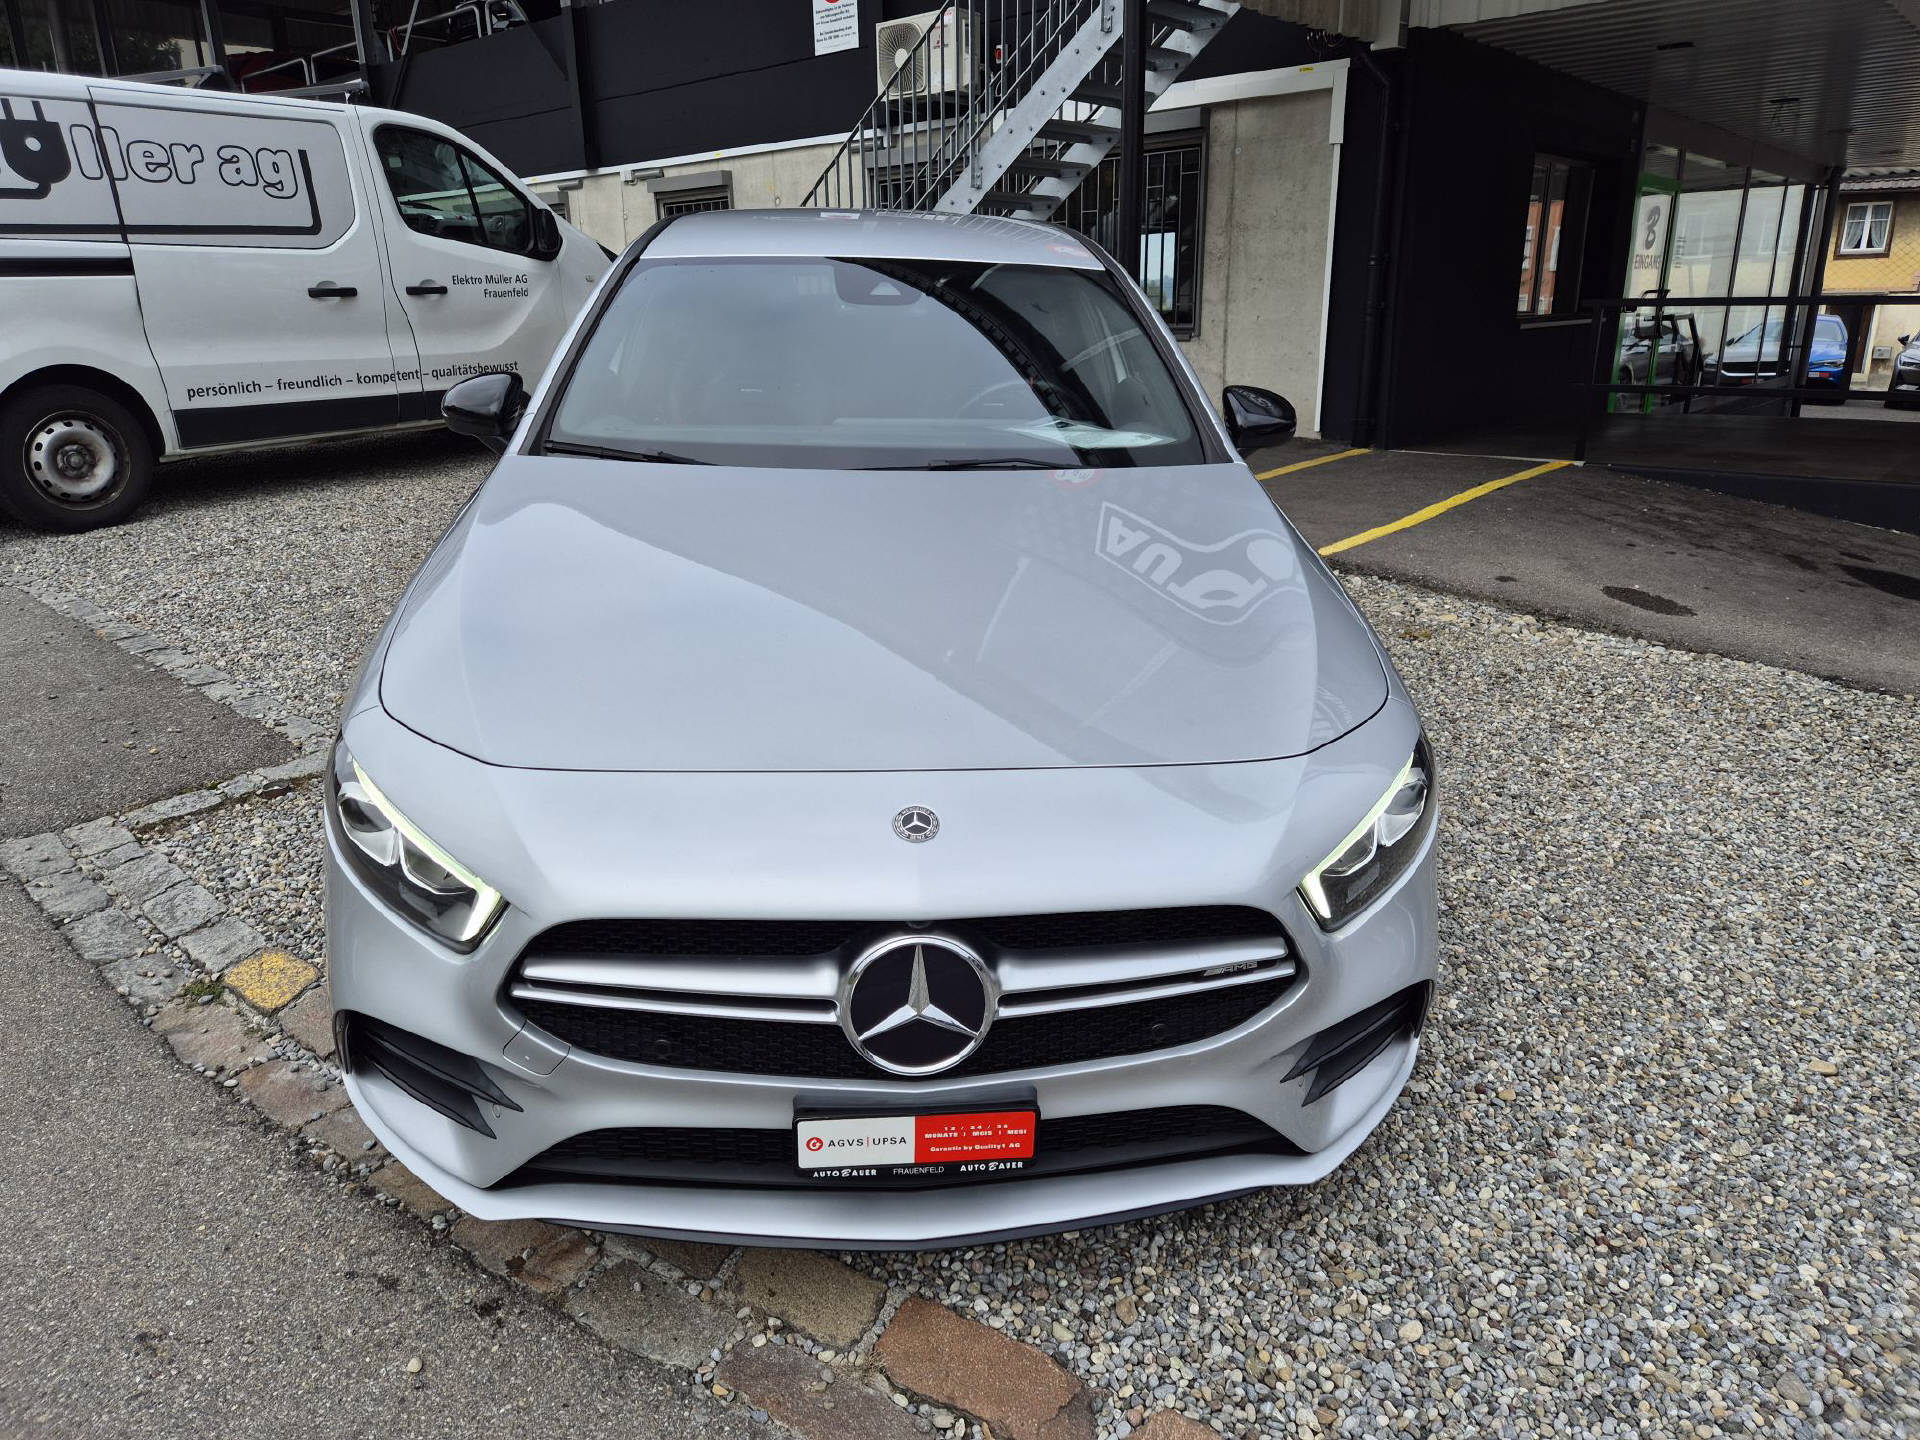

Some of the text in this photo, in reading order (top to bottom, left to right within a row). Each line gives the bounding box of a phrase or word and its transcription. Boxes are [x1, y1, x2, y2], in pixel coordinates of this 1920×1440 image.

[217, 145, 299, 199] ag
[452, 273, 528, 285] Elektro Müller AG
[484, 287, 529, 298] Frauenfeld
[187, 381, 262, 402] persönlich
[277, 374, 342, 391] freundlich
[356, 369, 420, 385] kompetent
[431, 361, 518, 380] qualitätsbewusst
[828, 1136, 907, 1148] AGVS UPSA
[893, 1166, 945, 1175] FRAUENFELD
